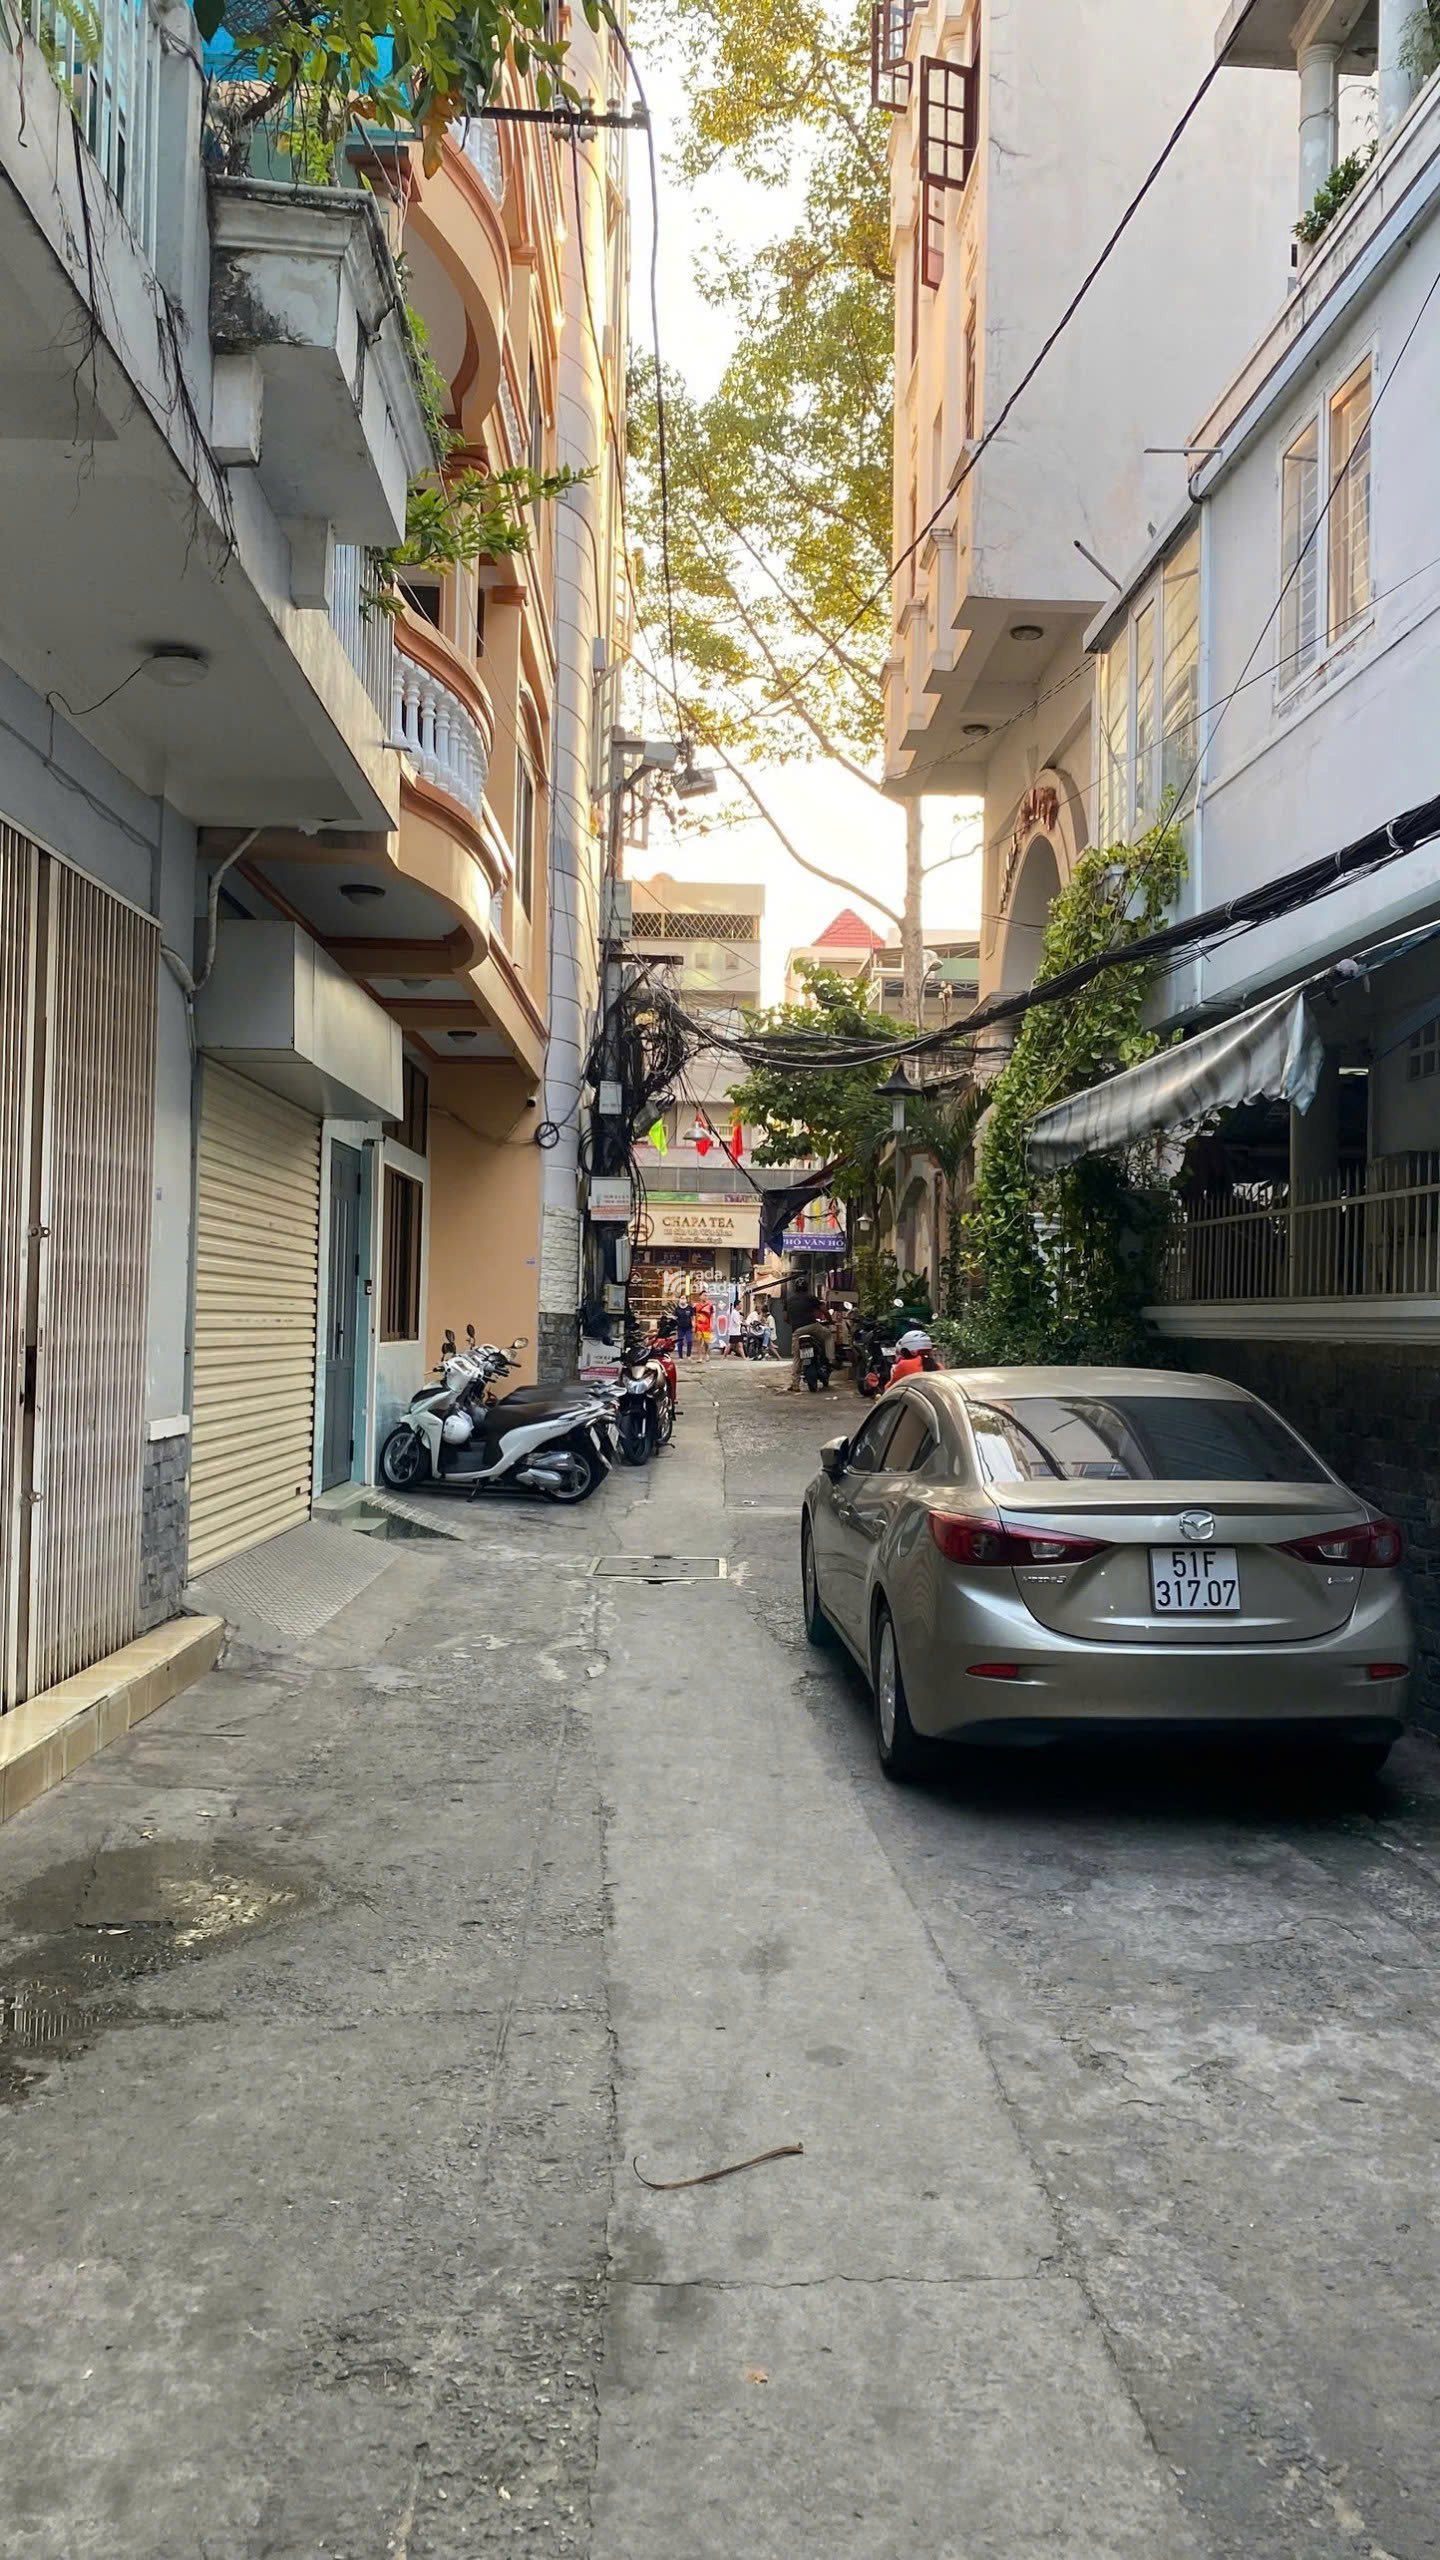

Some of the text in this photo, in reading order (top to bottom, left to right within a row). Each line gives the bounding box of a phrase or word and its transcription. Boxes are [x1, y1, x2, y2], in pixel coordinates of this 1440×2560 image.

[662, 1216, 735, 1229] CHAPA TEA
[1172, 1551, 1216, 1577] 51F
[1156, 1580, 1236, 1606] 317.07
